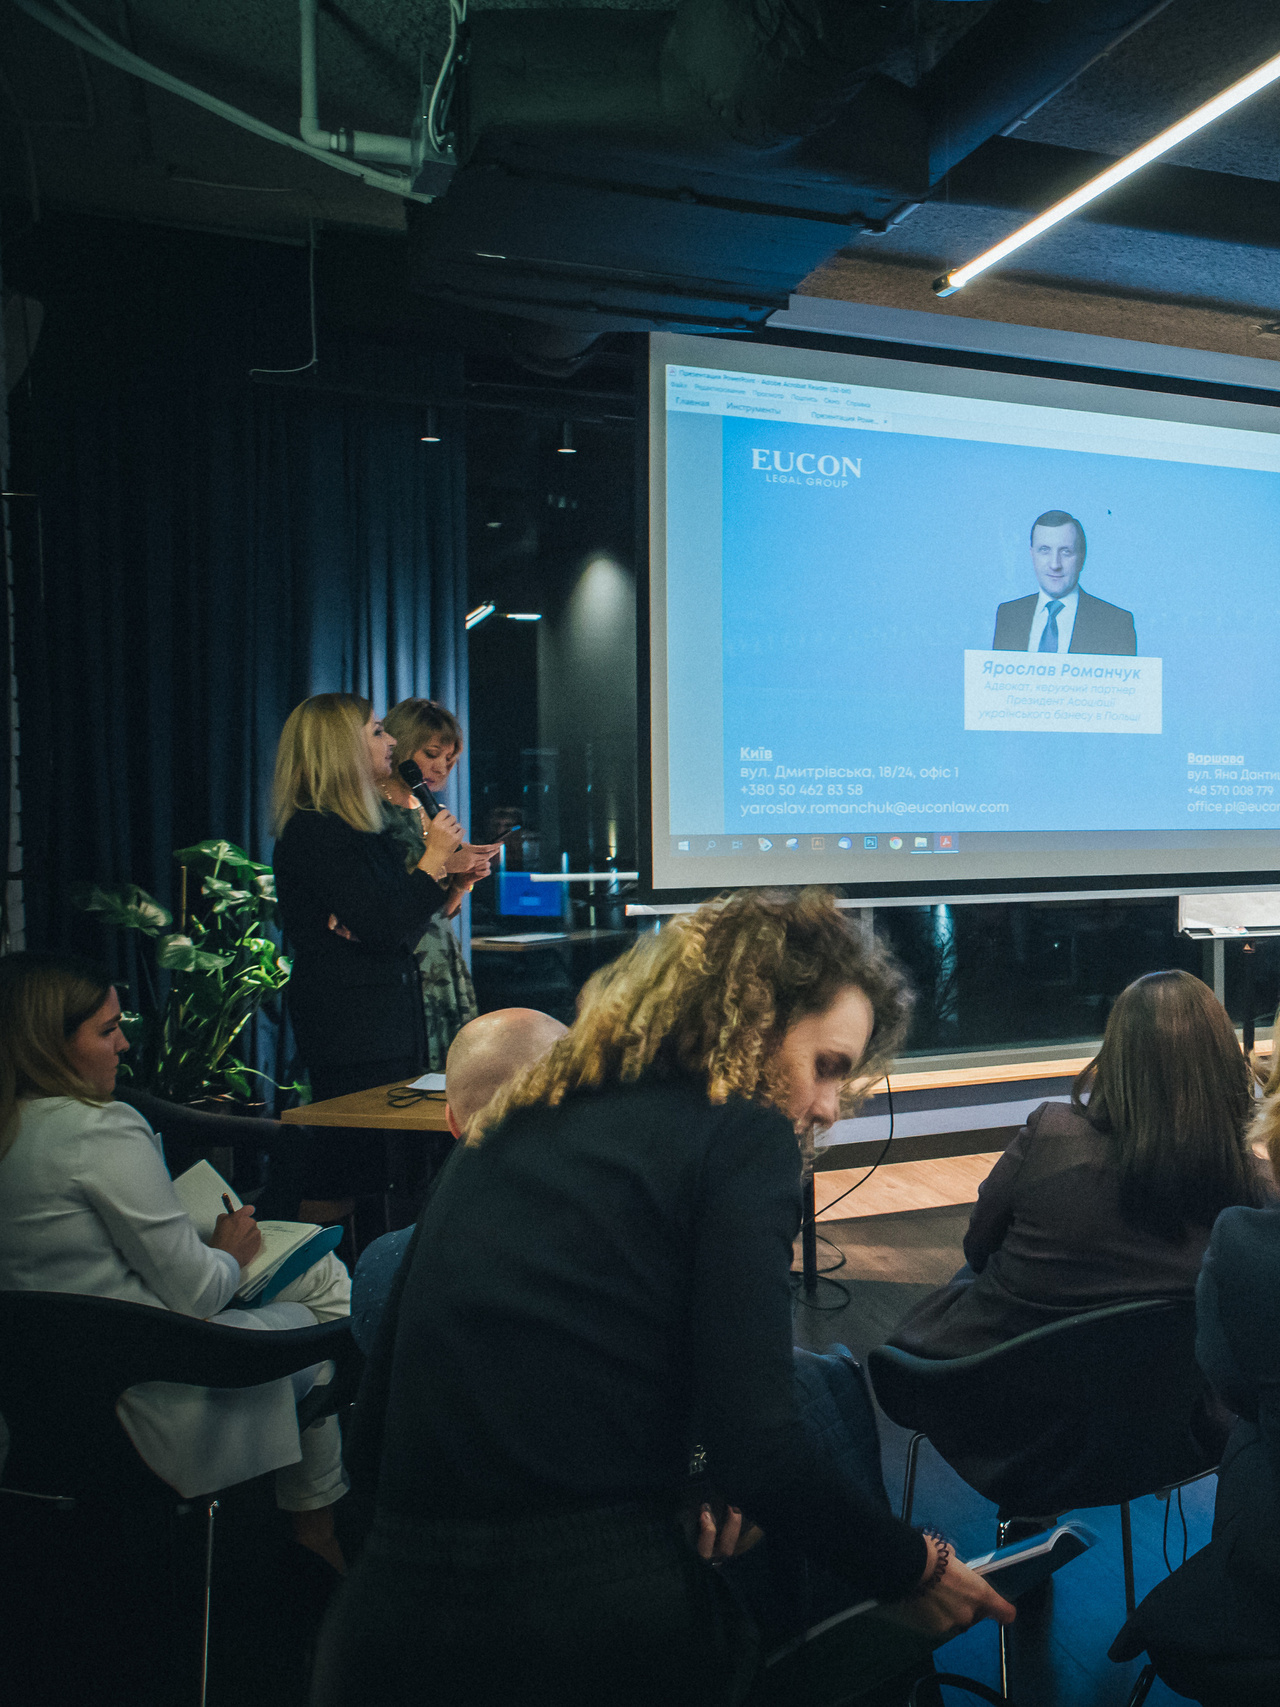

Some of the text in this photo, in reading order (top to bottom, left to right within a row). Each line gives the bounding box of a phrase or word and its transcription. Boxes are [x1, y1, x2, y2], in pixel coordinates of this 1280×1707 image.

[726, 401, 782, 415] Инструменты
[751, 448, 862, 479] EUCON
[765, 474, 849, 489] LEGAL GROUP
[982, 660, 1142, 682] Ярослав Романчук
[1091, 684, 1137, 696] партнер
[1006, 695, 1065, 707] Президент
[978, 708, 1051, 720] українського
[1053, 708, 1093, 722] бізнесу
[740, 746, 773, 761] Київ
[1187, 752, 1245, 765] Варшава
[740, 765, 959, 781] вул. Дмитрівська, 18/24, офіс 1
[1187, 770, 1212, 782] вул.
[1214, 769, 1238, 781] Яна
[740, 784, 864, 796] +380 50 462 83 58
[1187, 785, 1274, 796] +48 570 008 779
[740, 801, 1010, 818] yaroslav.romanchuk@euconlaw.com
